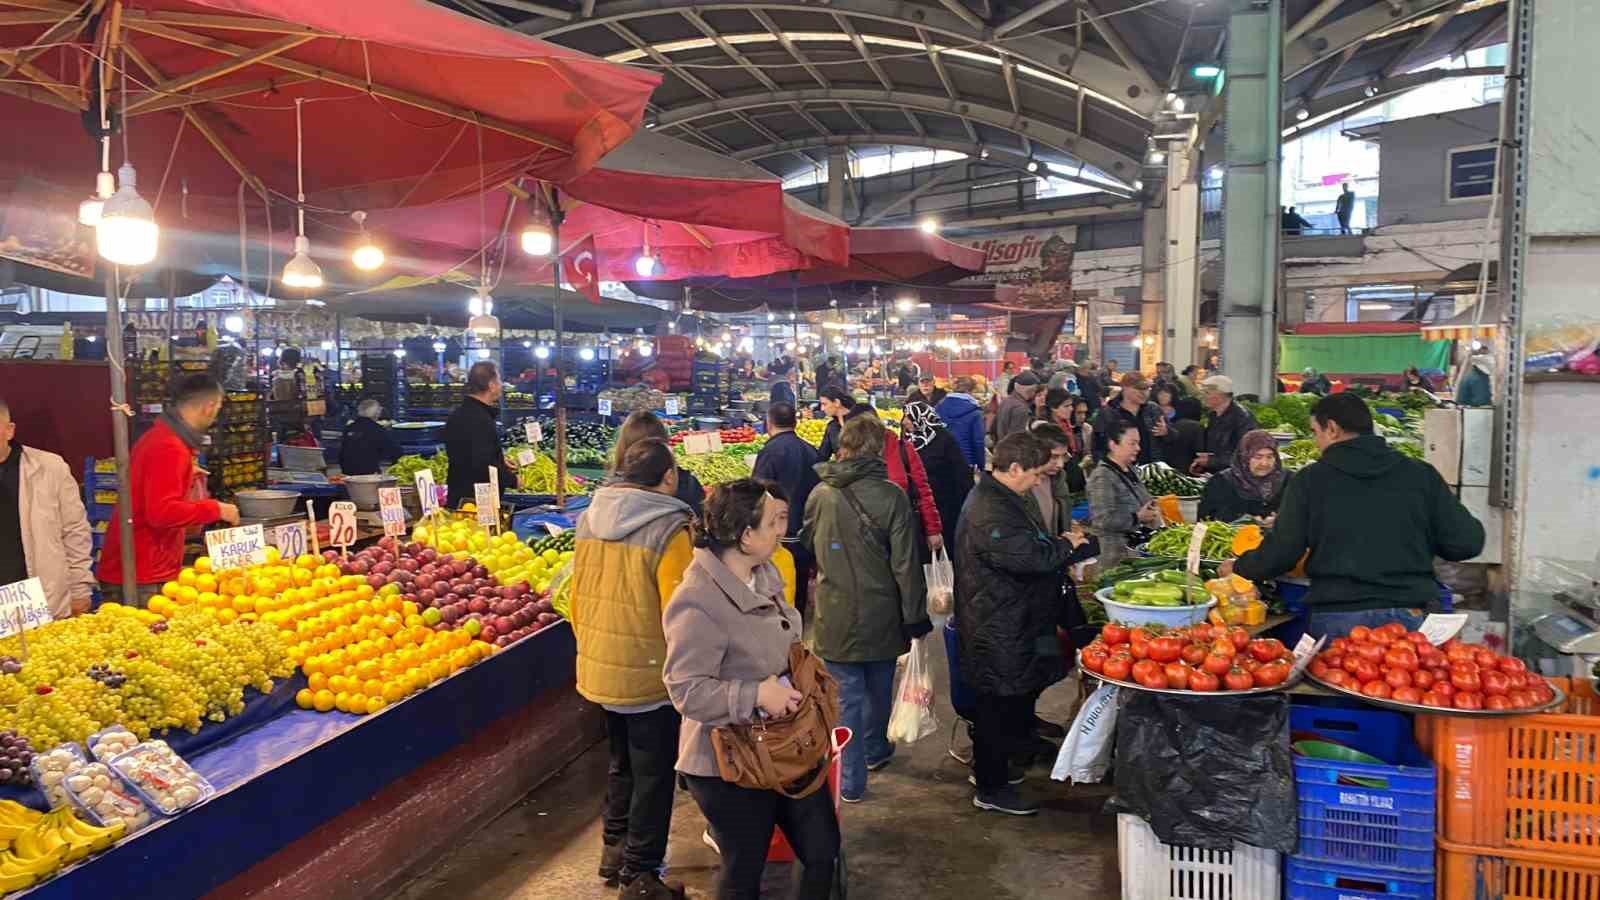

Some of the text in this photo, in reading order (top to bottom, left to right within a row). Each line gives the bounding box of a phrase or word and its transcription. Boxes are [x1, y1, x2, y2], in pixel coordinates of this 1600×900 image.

[418, 476, 437, 513] 20
[281, 528, 303, 560] 20
[332, 512, 354, 545] 20
